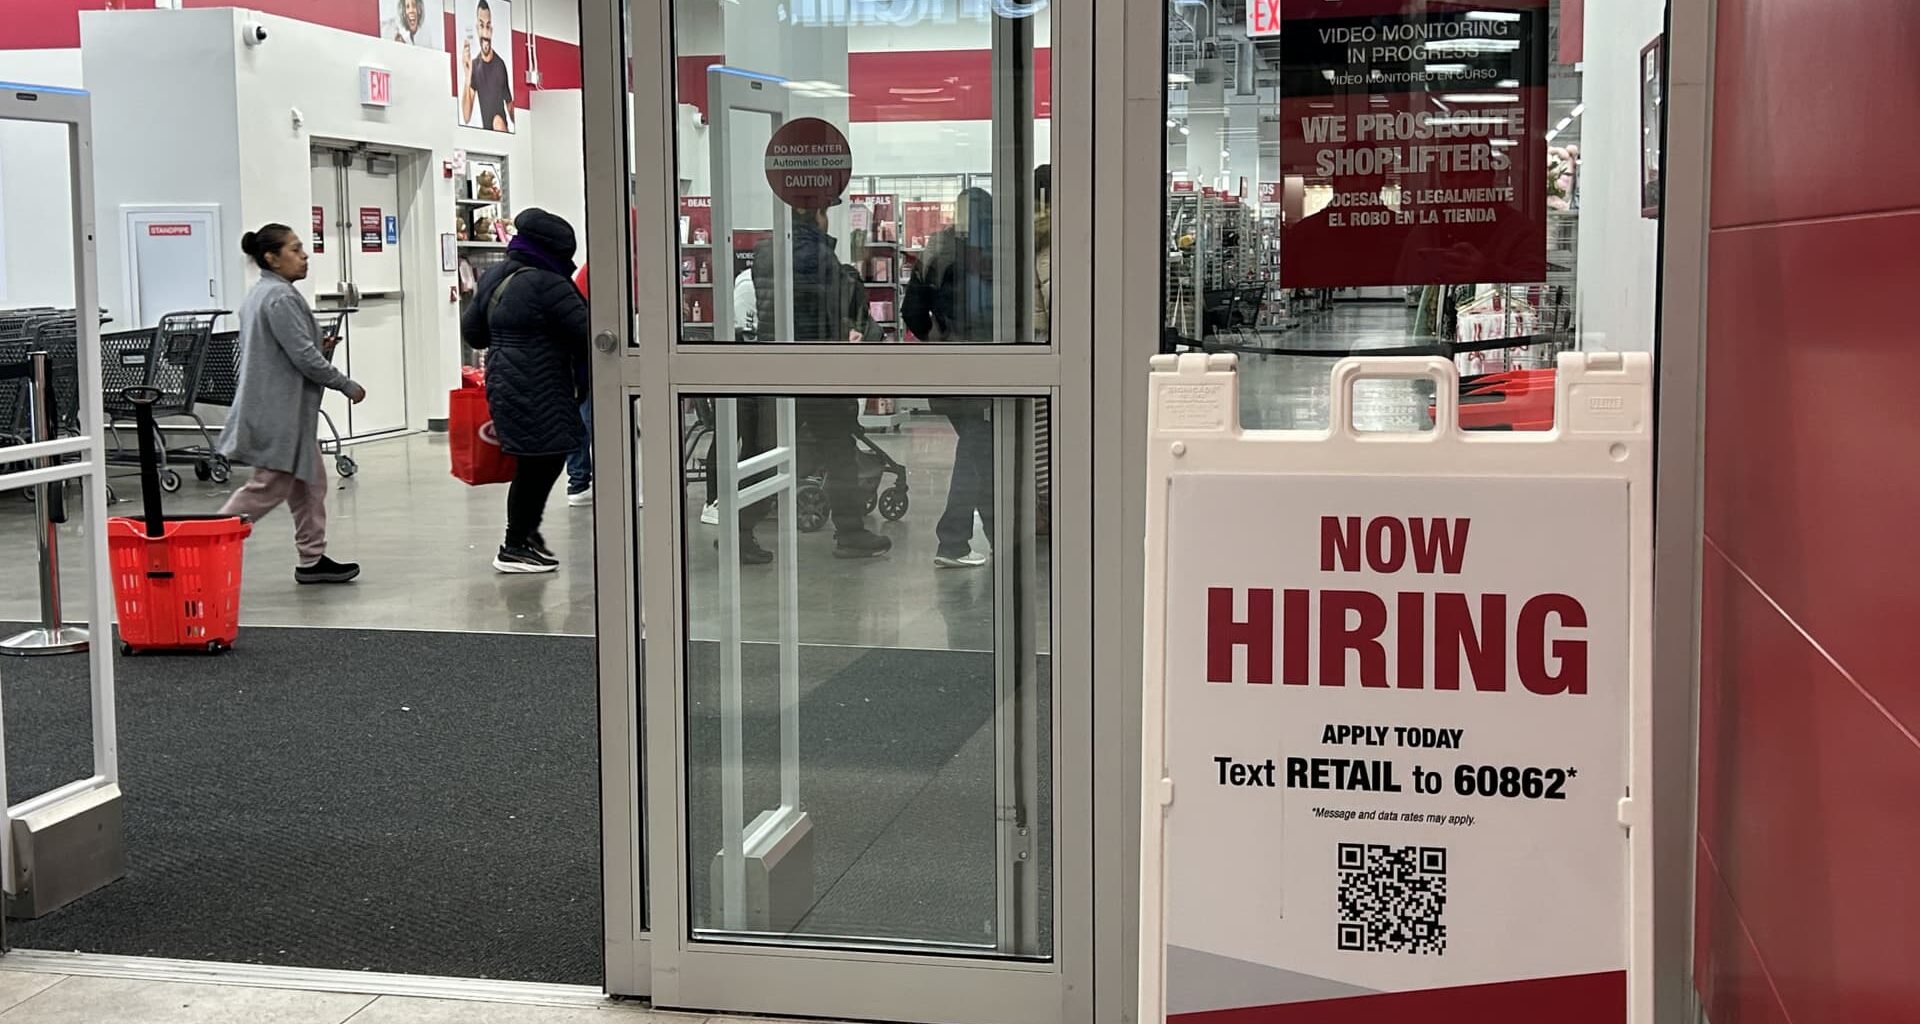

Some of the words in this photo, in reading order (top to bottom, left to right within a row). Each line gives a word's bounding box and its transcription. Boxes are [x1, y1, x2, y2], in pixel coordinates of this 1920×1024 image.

[1319, 26, 1376, 44] VIDEO
[1382, 20, 1508, 41] MONITORING
[1347, 48, 1366, 64] IN
[1372, 45, 1480, 62] PROGRESS
[370, 70, 390, 102] EXIT
[1330, 75, 1363, 85] VIDEO
[1365, 72, 1434, 84] MONITOREO
[1437, 71, 1453, 80] EN
[1456, 69, 1497, 79] CURSO
[1301, 115, 1347, 143] WE
[1357, 108, 1525, 141] PROSECUTE
[774, 145, 788, 154] DO
[790, 145, 808, 154] NOT
[811, 144, 842, 153] ENTER
[773, 157, 818, 167] Automatic
[822, 157, 843, 166] Door
[1316, 143, 1511, 177] SHOPLIFTERS
[785, 174, 833, 188] CAUTION
[1416, 187, 1514, 205] LEGALMENTE
[1328, 213, 1346, 227] EL
[1350, 211, 1390, 226] ROBO
[1395, 210, 1414, 225] EN
[1420, 210, 1439, 224] LA
[1442, 208, 1497, 223] TIENDA
[1321, 515, 1471, 574] NOW
[1207, 587, 1588, 696] HIRING
[1322, 724, 1390, 747] APPLY
[1394, 727, 1464, 749] TODAY
[1214, 756, 1276, 788] Text
[1286, 757, 1402, 793] RETAIL
[1412, 765, 1443, 795] to
[1358, 810, 1377, 820] and
[1378, 811, 1398, 821] data
[1400, 812, 1424, 822] rates
[1426, 814, 1447, 826] may
[1448, 814, 1476, 826] apply.
